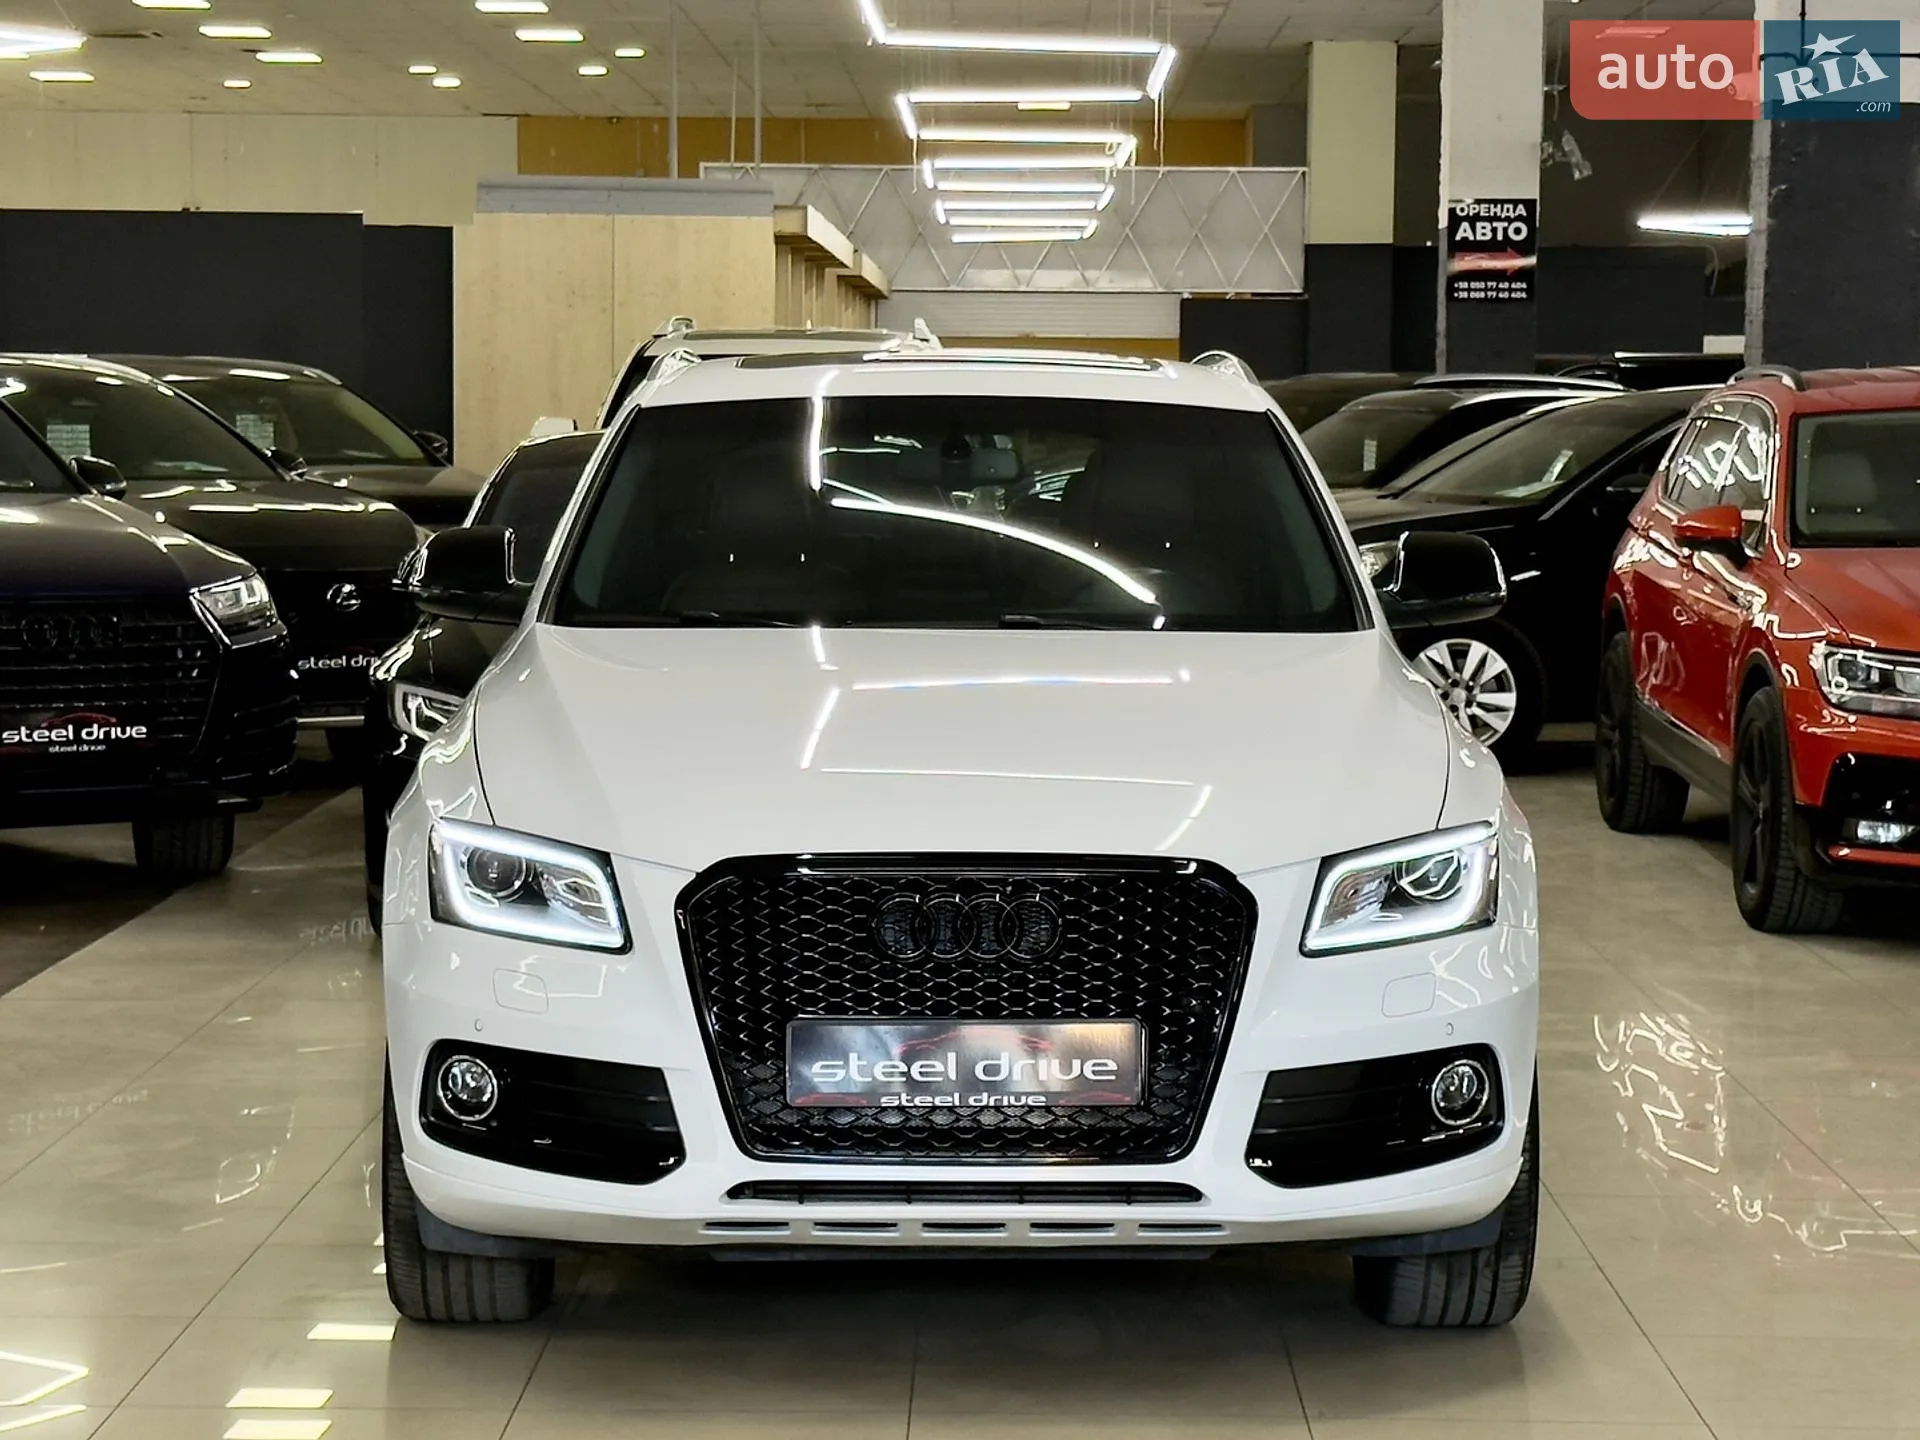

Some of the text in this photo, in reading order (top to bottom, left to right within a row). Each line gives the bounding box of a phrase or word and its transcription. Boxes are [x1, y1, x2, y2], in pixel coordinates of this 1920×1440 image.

[1455, 203, 1527, 219] ОРЕНДА
[1455, 221, 1528, 241] АВТО
[297, 654, 379, 670] steel dri
[1, 723, 148, 743] steel drive
[48, 744, 77, 753] steel
[811, 1051, 1119, 1082] steel drive
[880, 1092, 1047, 1107] steel drive
